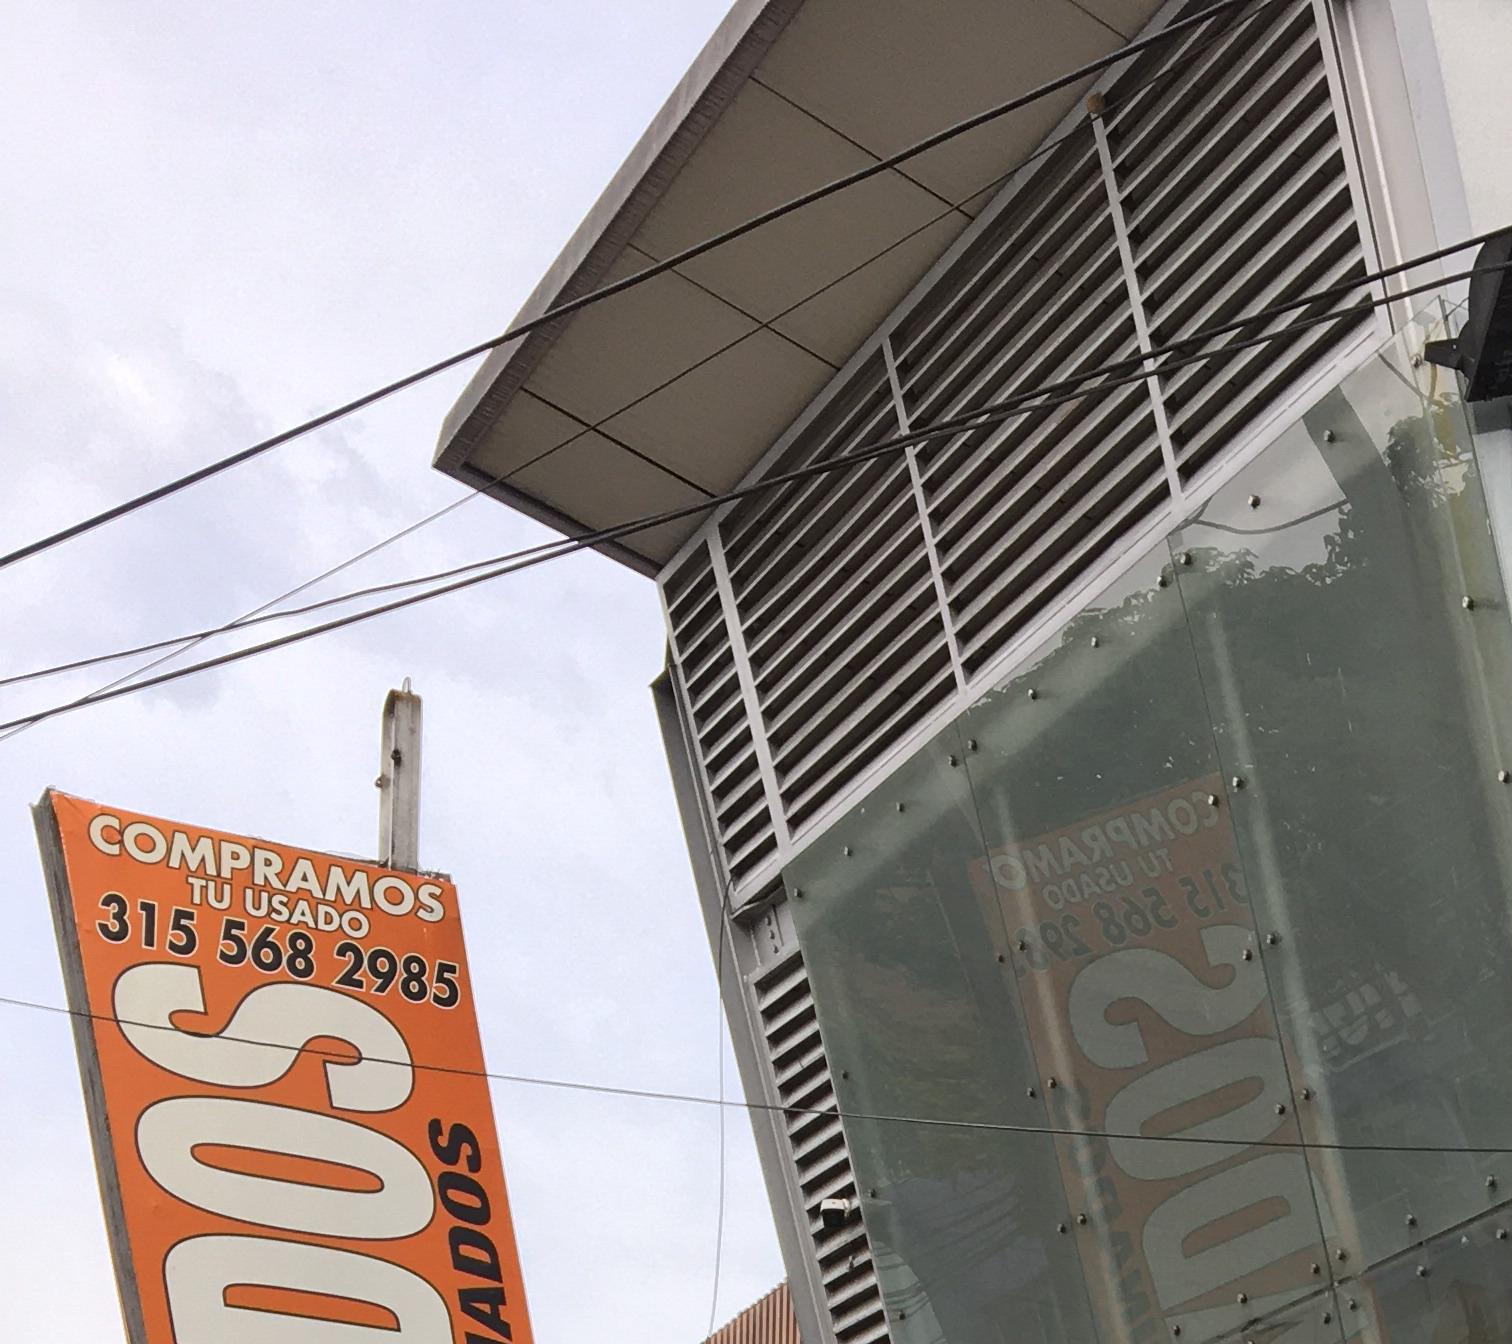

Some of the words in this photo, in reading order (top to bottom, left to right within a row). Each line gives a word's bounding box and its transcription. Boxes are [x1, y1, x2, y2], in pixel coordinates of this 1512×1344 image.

[88, 813, 445, 923] COMPRAMOS
[186, 876, 231, 910] TU
[245, 887, 370, 939] USADO
[96, 891, 198, 957] 315
[217, 917, 315, 980] 568
[331, 940, 460, 1009] 2985
